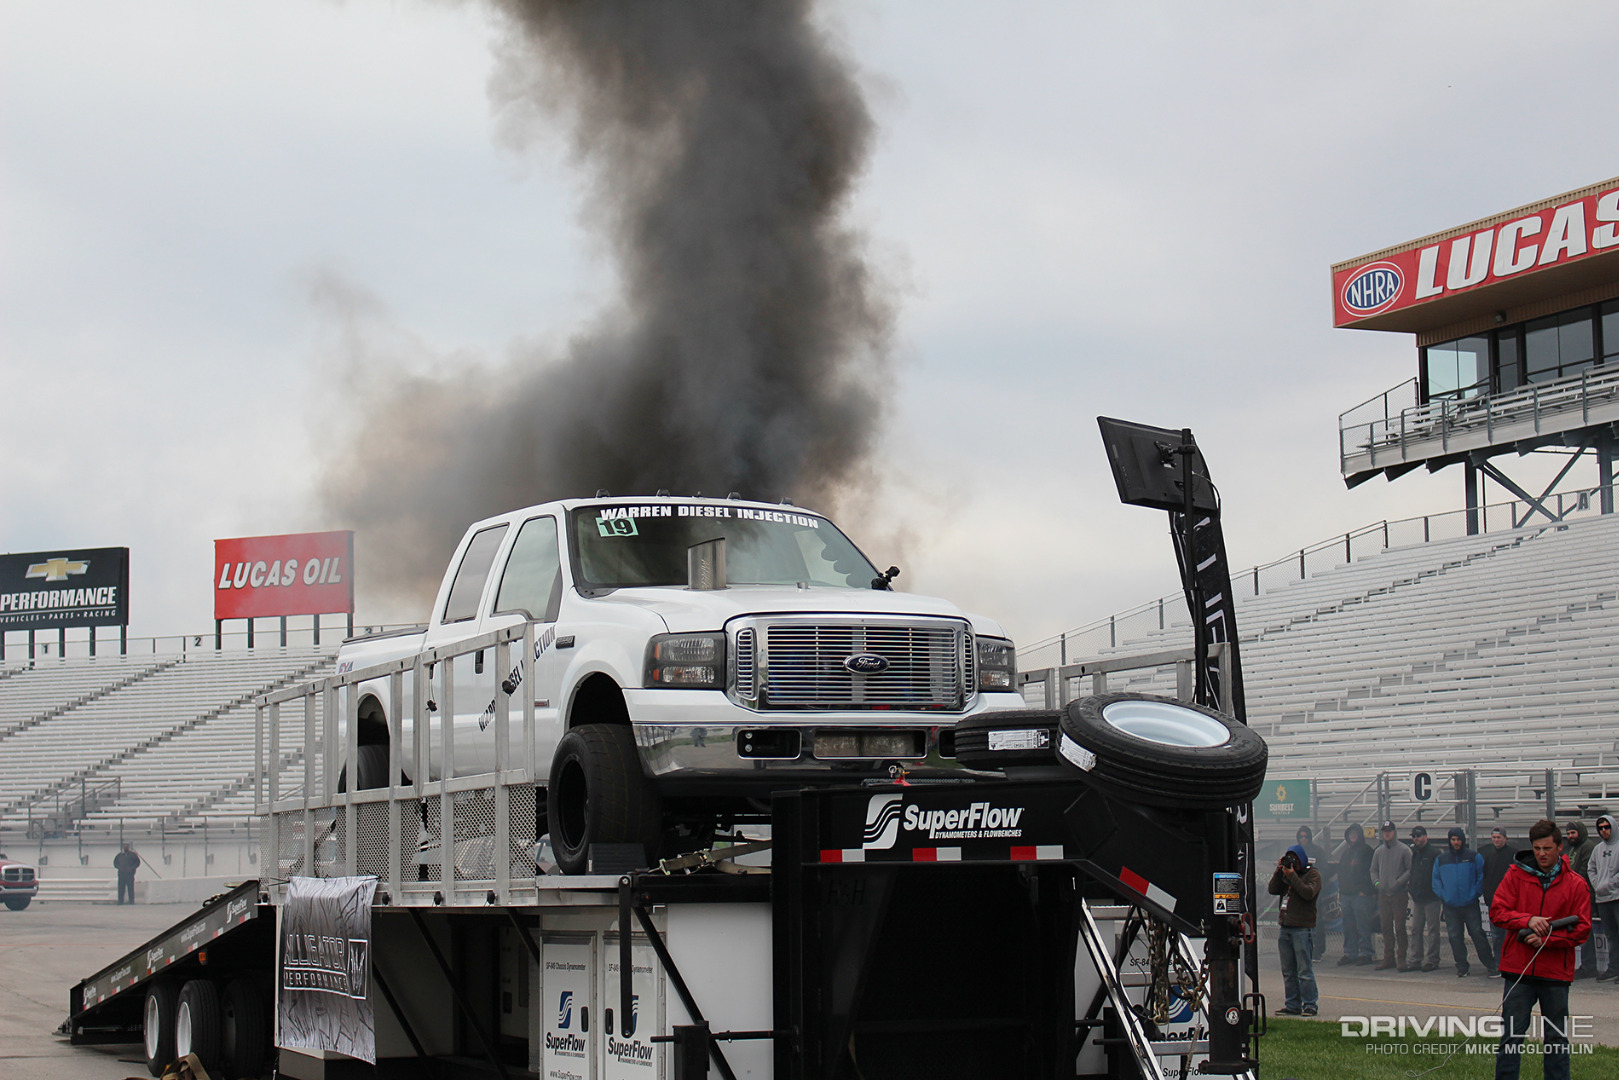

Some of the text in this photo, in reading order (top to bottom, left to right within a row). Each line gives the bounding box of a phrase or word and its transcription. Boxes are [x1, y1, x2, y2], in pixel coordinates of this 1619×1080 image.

[1416, 190, 1619, 300] LUCAS
[1350, 270, 1398, 308] NHRA
[1579, 492, 1589, 510] A
[599, 519, 634, 535] 19
[600, 506, 819, 529] WARREN DIESEL INJECTION
[218, 557, 342, 590] LUCAS OIL
[0, 586, 117, 612] PERFORMANCE
[48, 612, 75, 620] PARTS
[83, 609, 117, 618] RACING
[194, 636, 202, 647] 2
[856, 656, 881, 670] Ford
[1414, 772, 1432, 801] C
[903, 802, 1023, 839] SuperFlow
[935, 829, 1022, 839] DYNAMOMETERS & FLOWBENCHES
[546, 1032, 586, 1055] SuperFlow
[607, 1036, 653, 1062] SuperFlow
